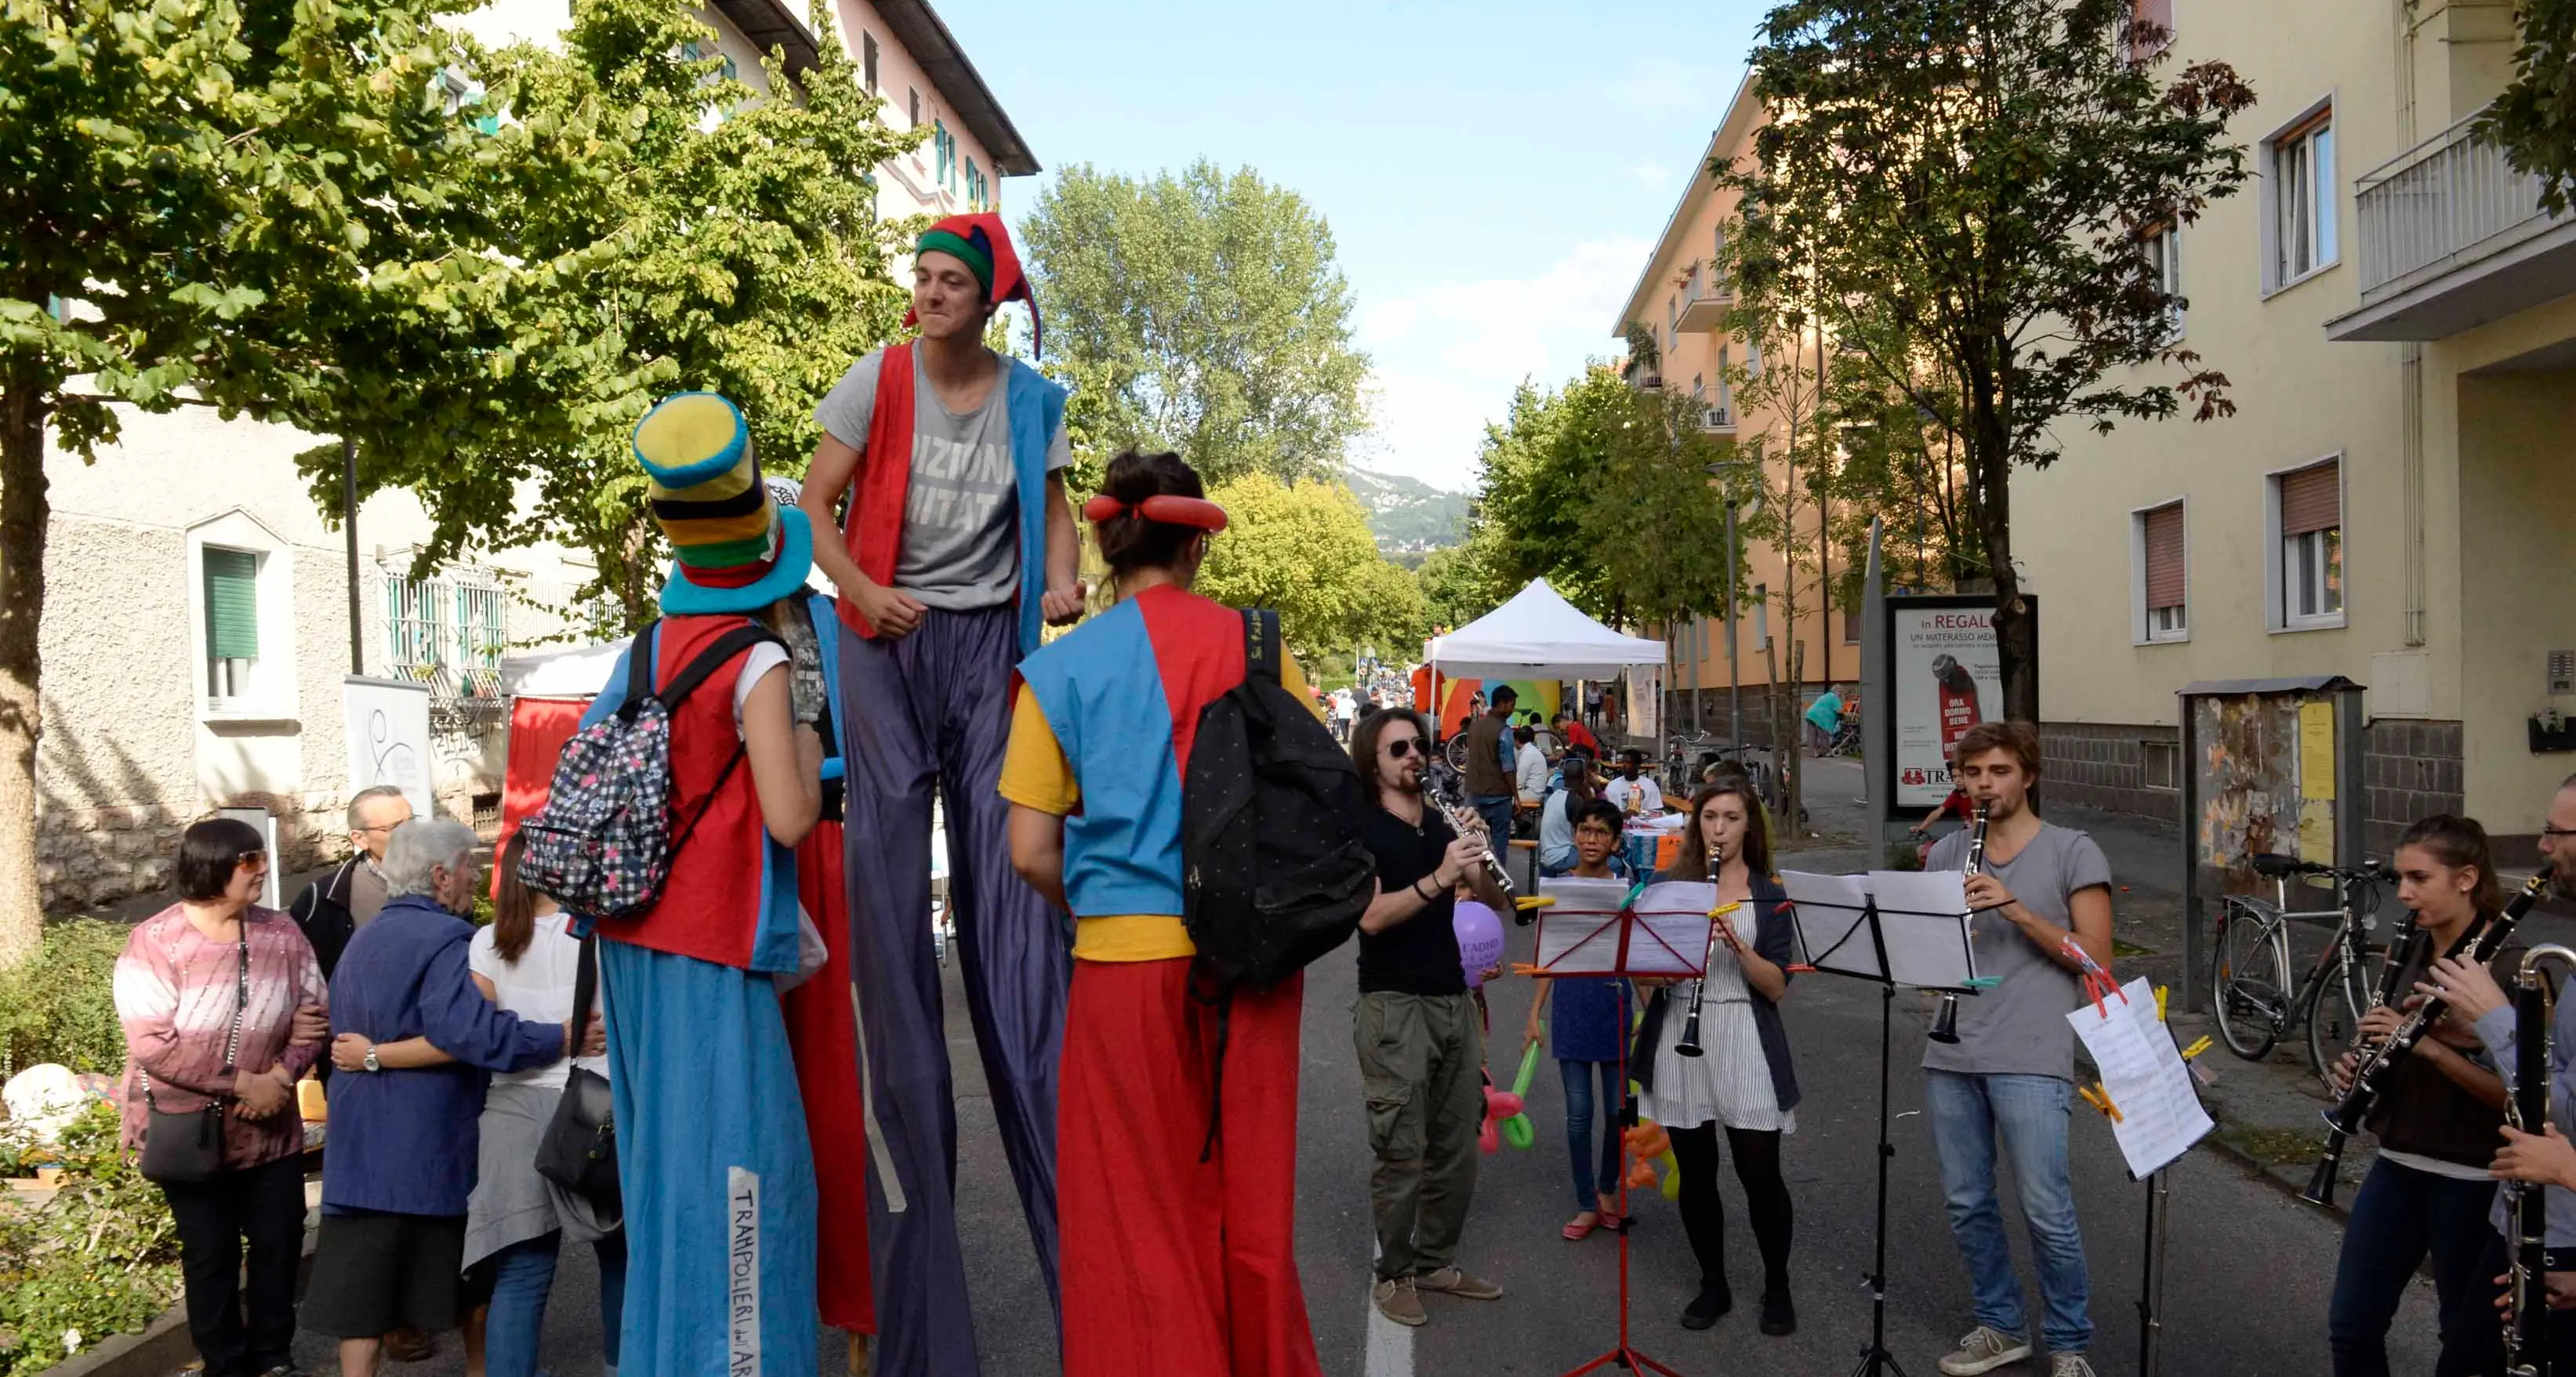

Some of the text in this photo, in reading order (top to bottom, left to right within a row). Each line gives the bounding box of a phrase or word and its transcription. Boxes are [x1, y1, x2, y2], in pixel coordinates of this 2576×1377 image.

[1935, 614, 1995, 629] REGAL
[1910, 632, 1923, 642] UN
[1925, 632, 1975, 642] MATERASSO
[1949, 698, 1965, 707] ORA
[1944, 707, 1971, 717] DORMO
[1949, 716, 1969, 726] BENE
